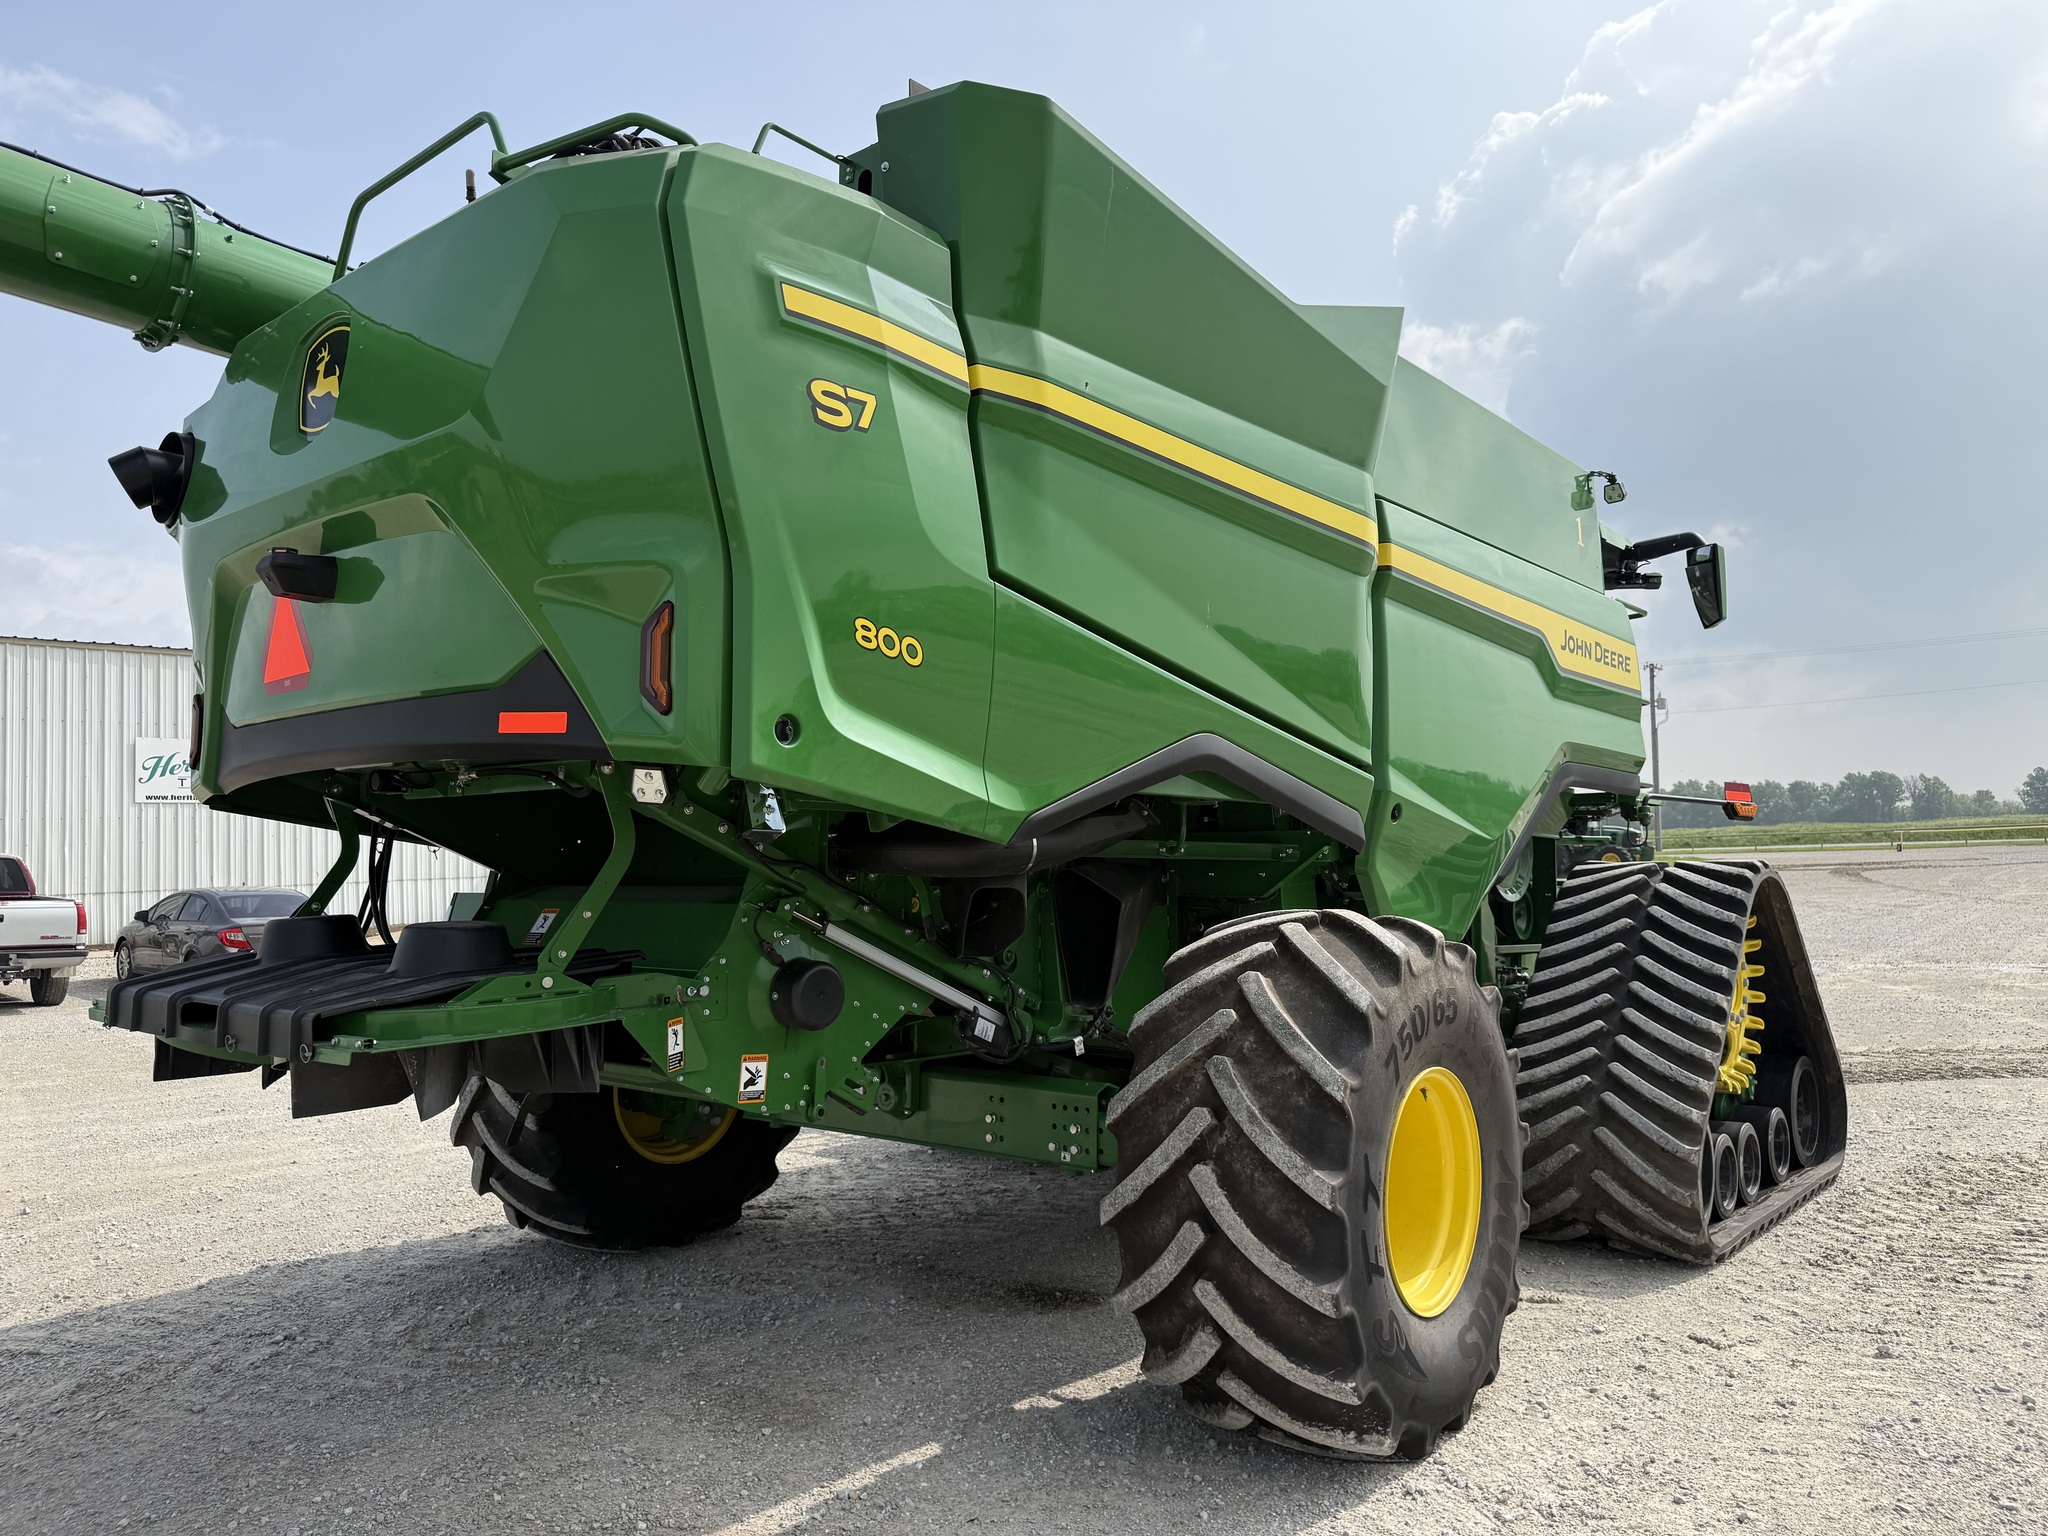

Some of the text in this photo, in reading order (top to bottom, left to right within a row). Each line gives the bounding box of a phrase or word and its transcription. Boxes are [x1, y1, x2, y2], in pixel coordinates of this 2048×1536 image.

[806, 377, 877, 433] S7
[854, 616, 924, 667] 800
[1560, 629, 1631, 674] JOHN DEERE
[1383, 987, 1458, 1087] 750/65
